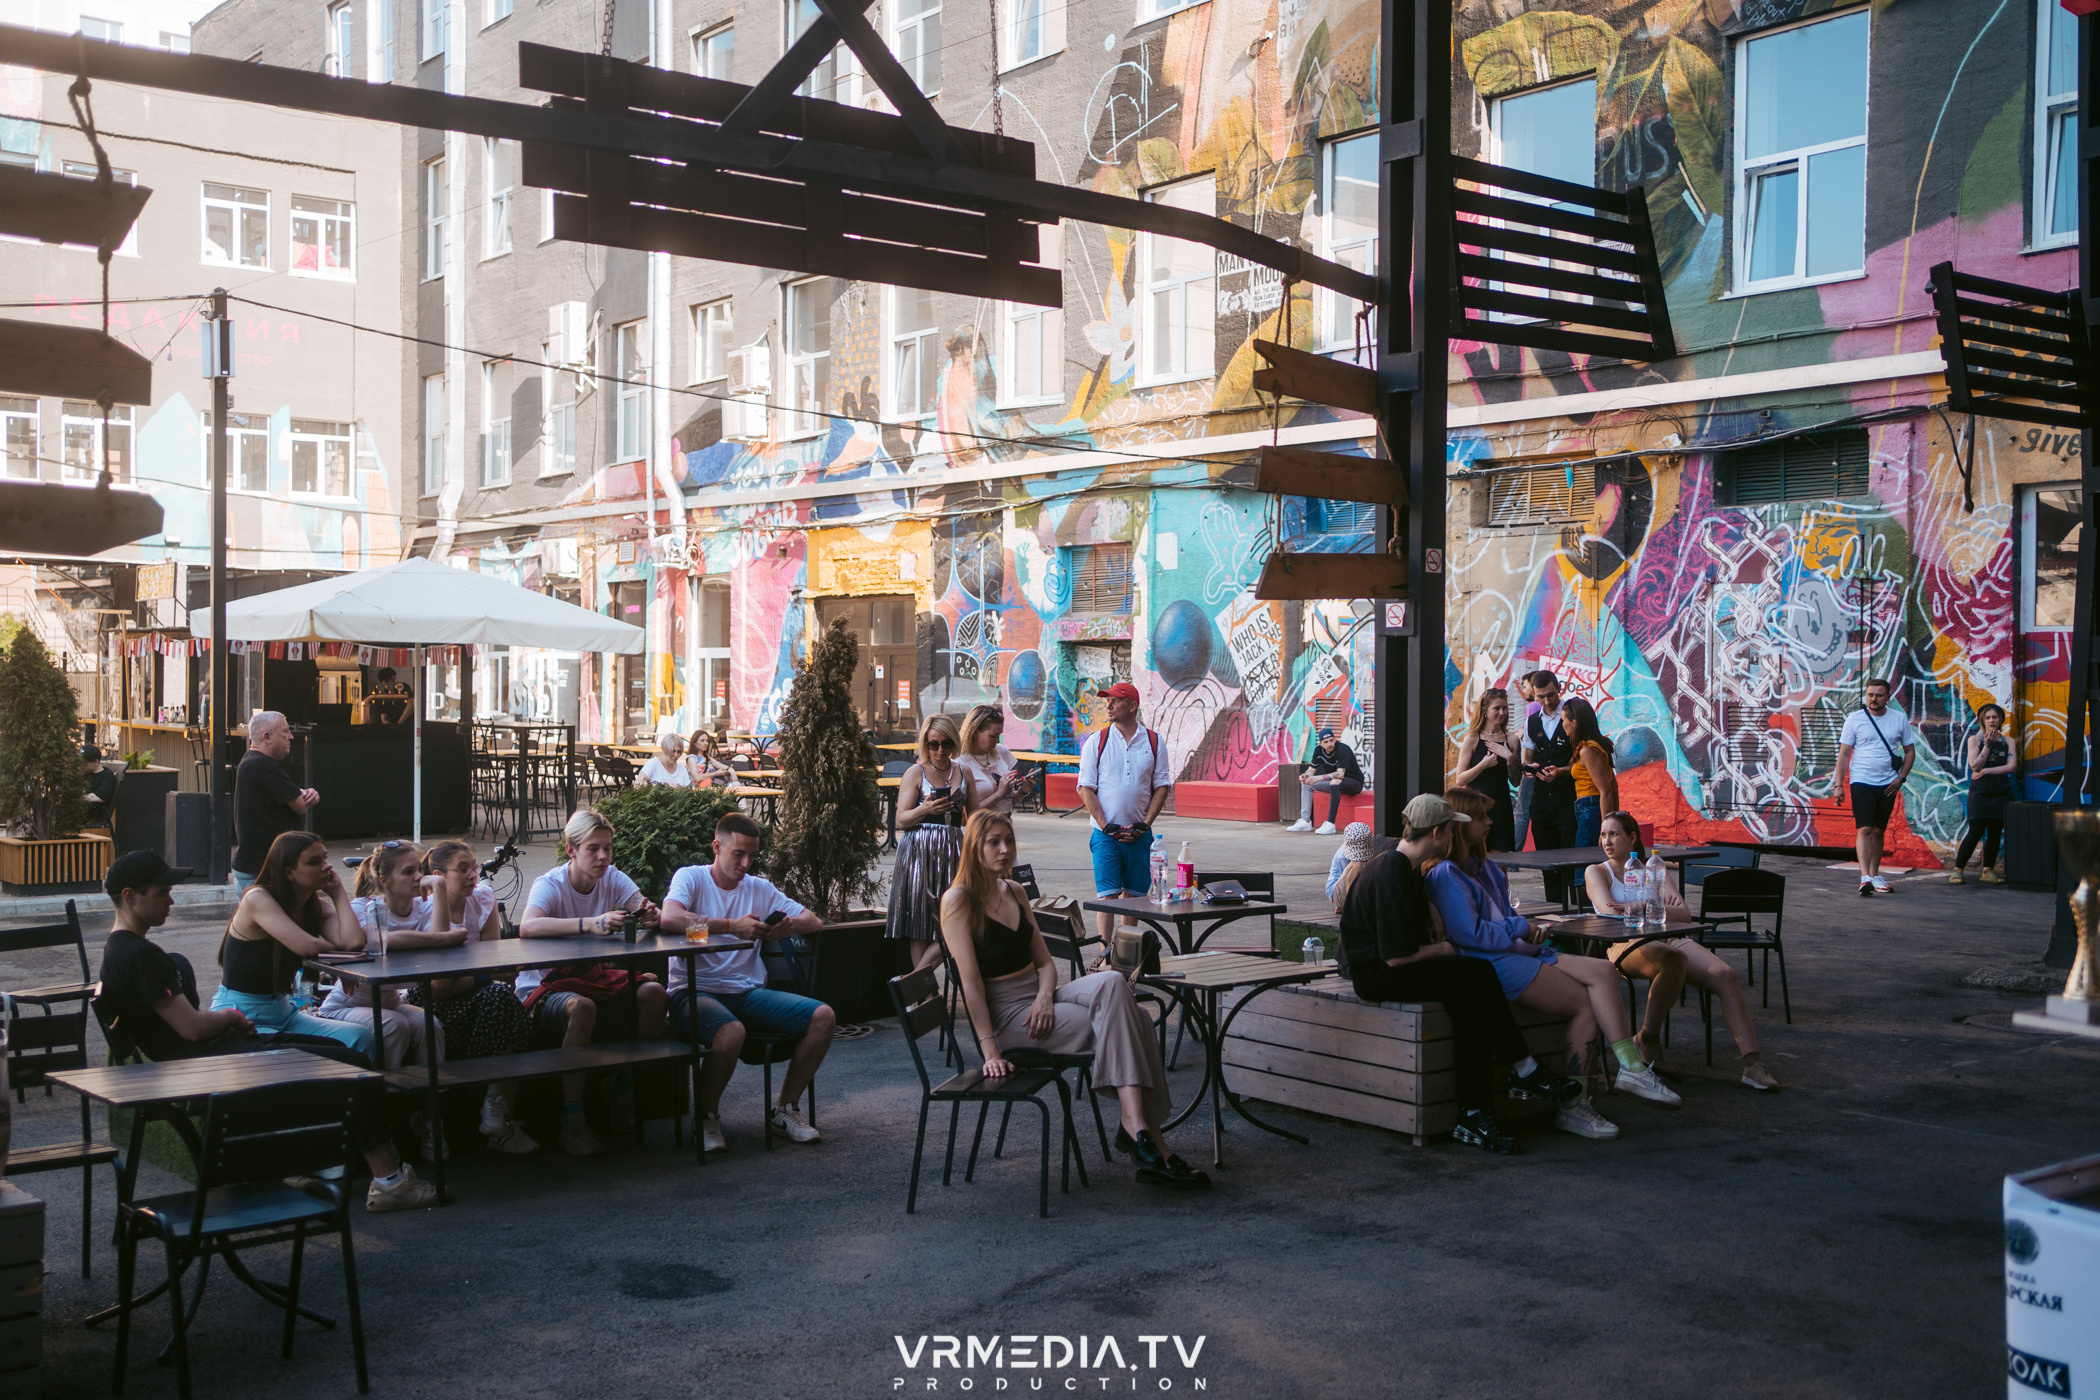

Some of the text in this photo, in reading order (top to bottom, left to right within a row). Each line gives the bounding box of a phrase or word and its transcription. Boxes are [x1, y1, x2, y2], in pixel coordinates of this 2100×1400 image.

[1253, 265, 1284, 287] MOO
[33, 291, 300, 345] РЕДАКИЯ
[1231, 623, 1257, 654] WHO
[1255, 612, 1269, 634] IS
[2006, 1284, 2063, 1312] РСКАЯ
